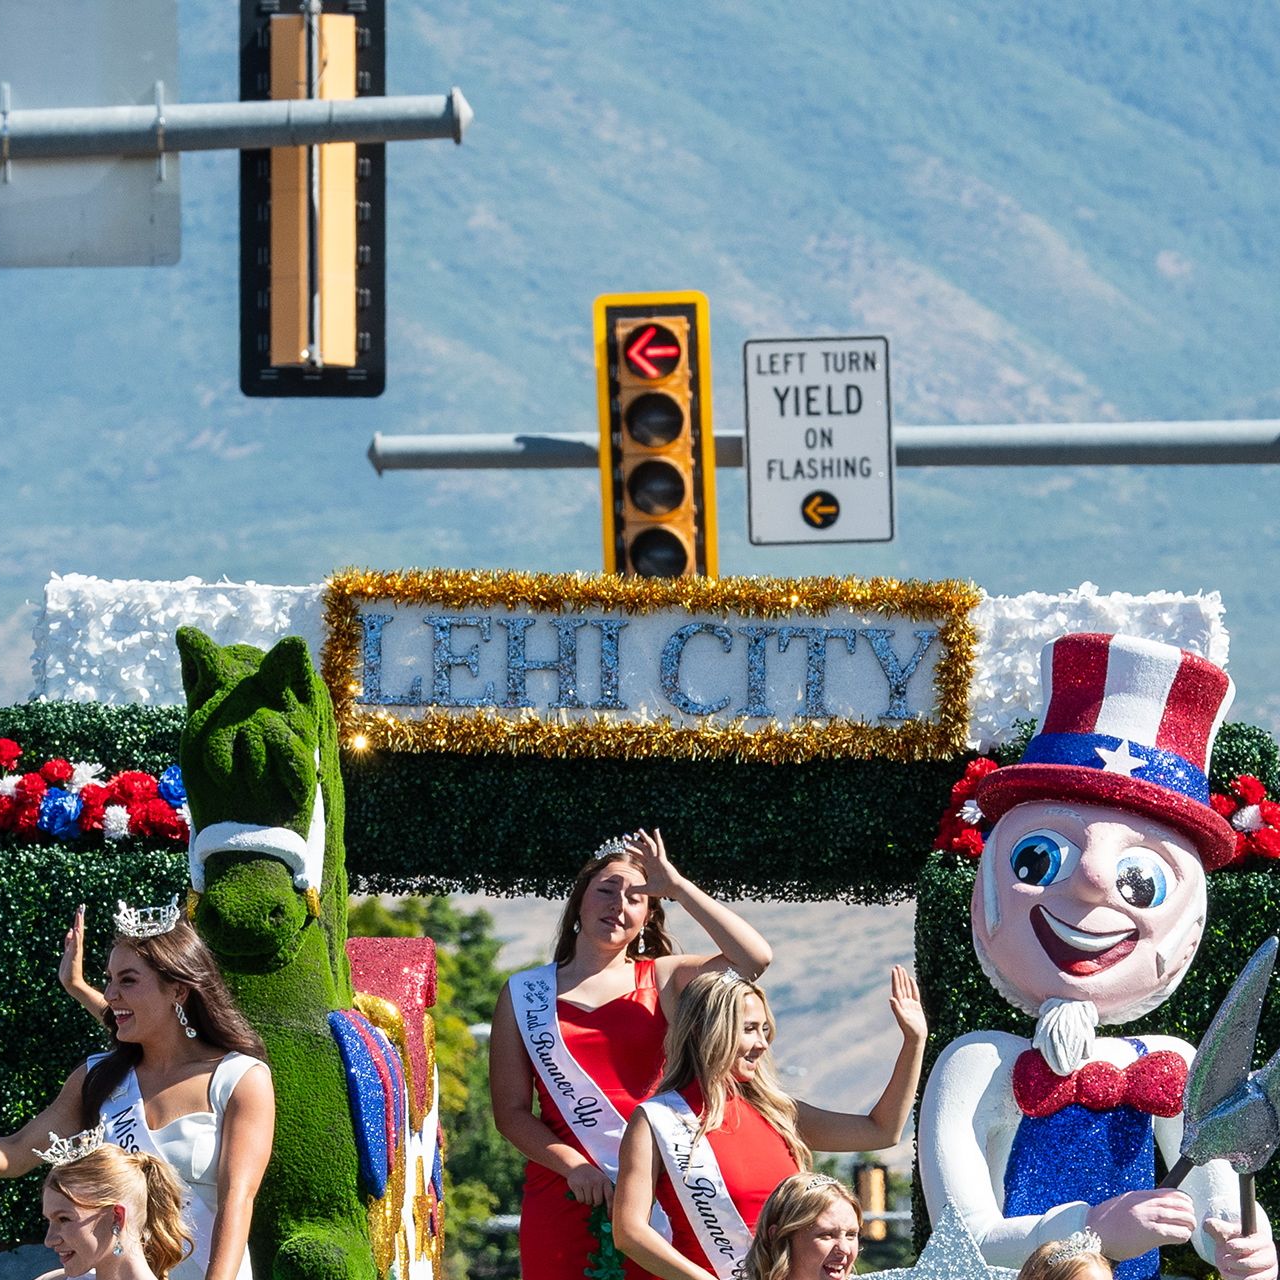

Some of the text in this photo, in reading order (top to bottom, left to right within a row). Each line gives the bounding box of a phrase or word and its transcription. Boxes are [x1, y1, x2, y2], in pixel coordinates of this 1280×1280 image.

[756, 351, 877, 375] LEFT TURN
[773, 384, 863, 418] YIELD
[804, 427, 833, 450] ON
[767, 456, 872, 481] FLASHING
[356, 614, 940, 722] LEHI CITY
[526, 1004, 598, 1128] 2nd Runner-Up
[111, 1105, 140, 1154] Miss
